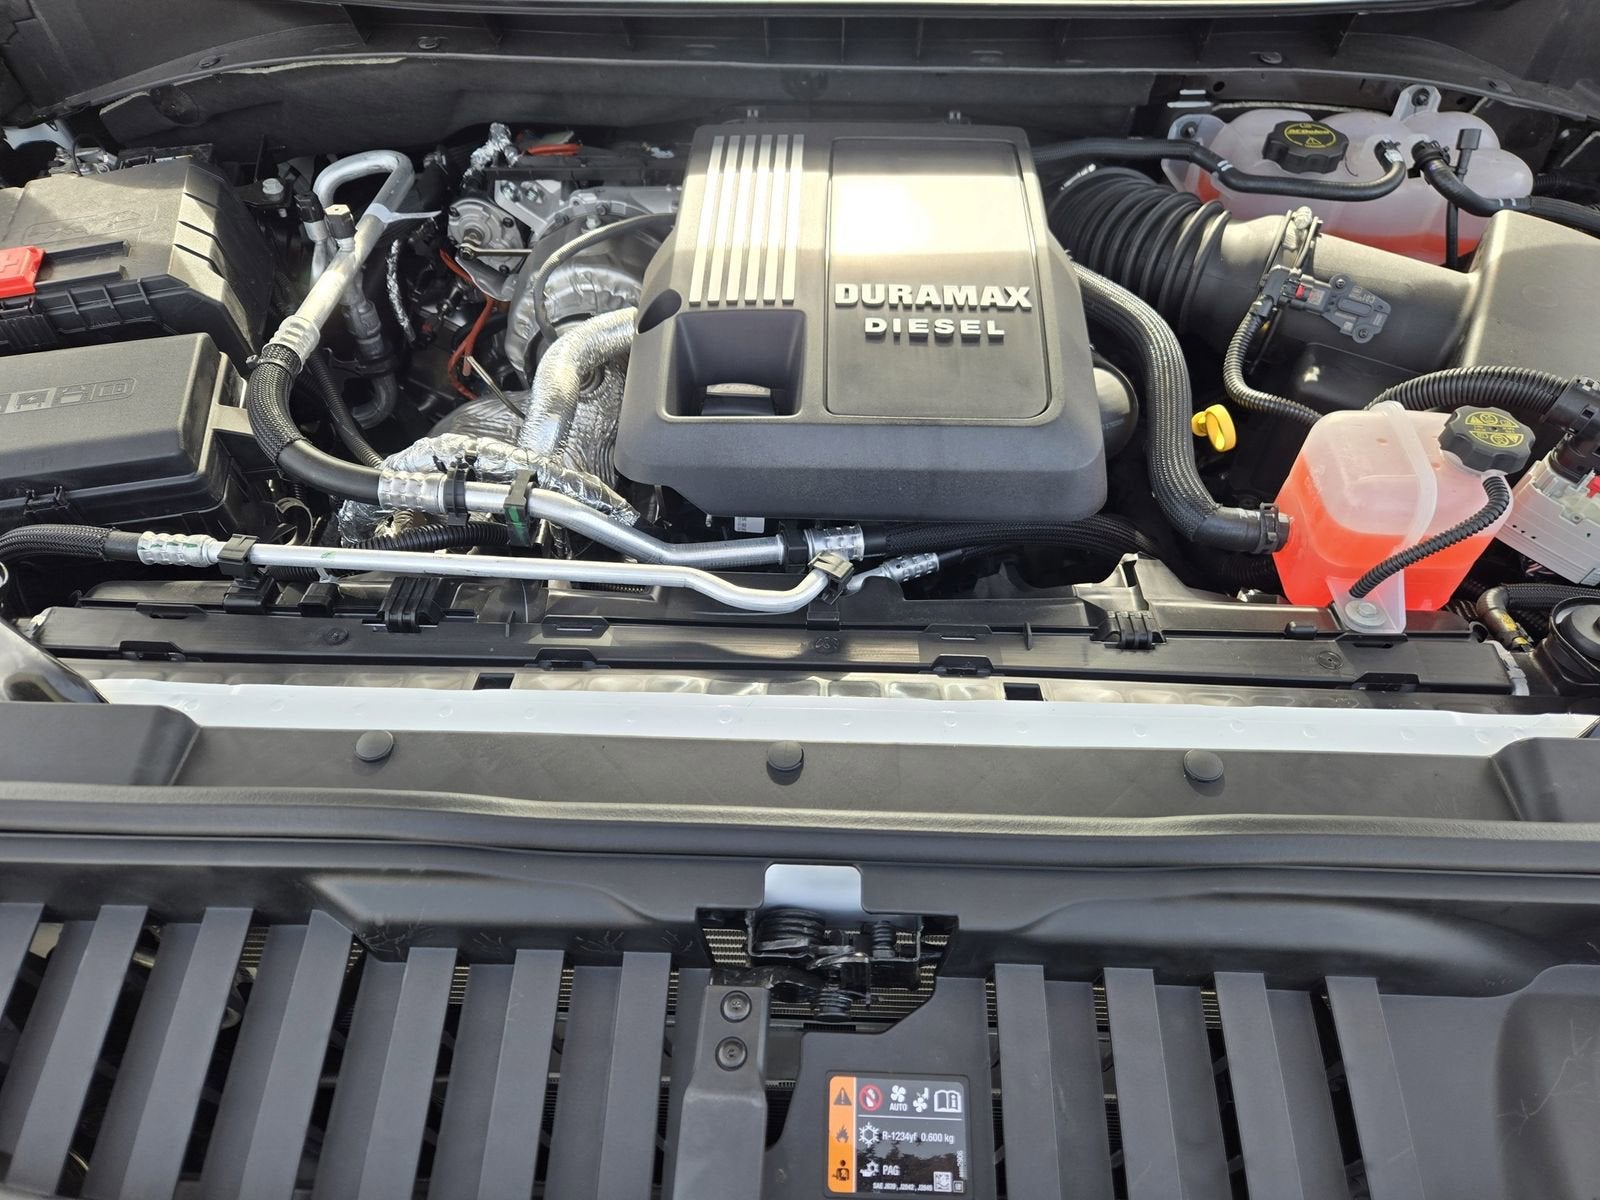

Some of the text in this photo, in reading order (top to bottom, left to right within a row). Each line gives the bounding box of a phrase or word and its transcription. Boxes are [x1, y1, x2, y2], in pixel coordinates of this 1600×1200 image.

[834, 283, 1033, 312] DURAMAX
[864, 317, 1005, 338] DIESEL
[889, 1103, 908, 1111] AUTO
[882, 1131, 954, 1144] R-1234yf 0.600 kg
[882, 1165, 900, 1176] PAG
